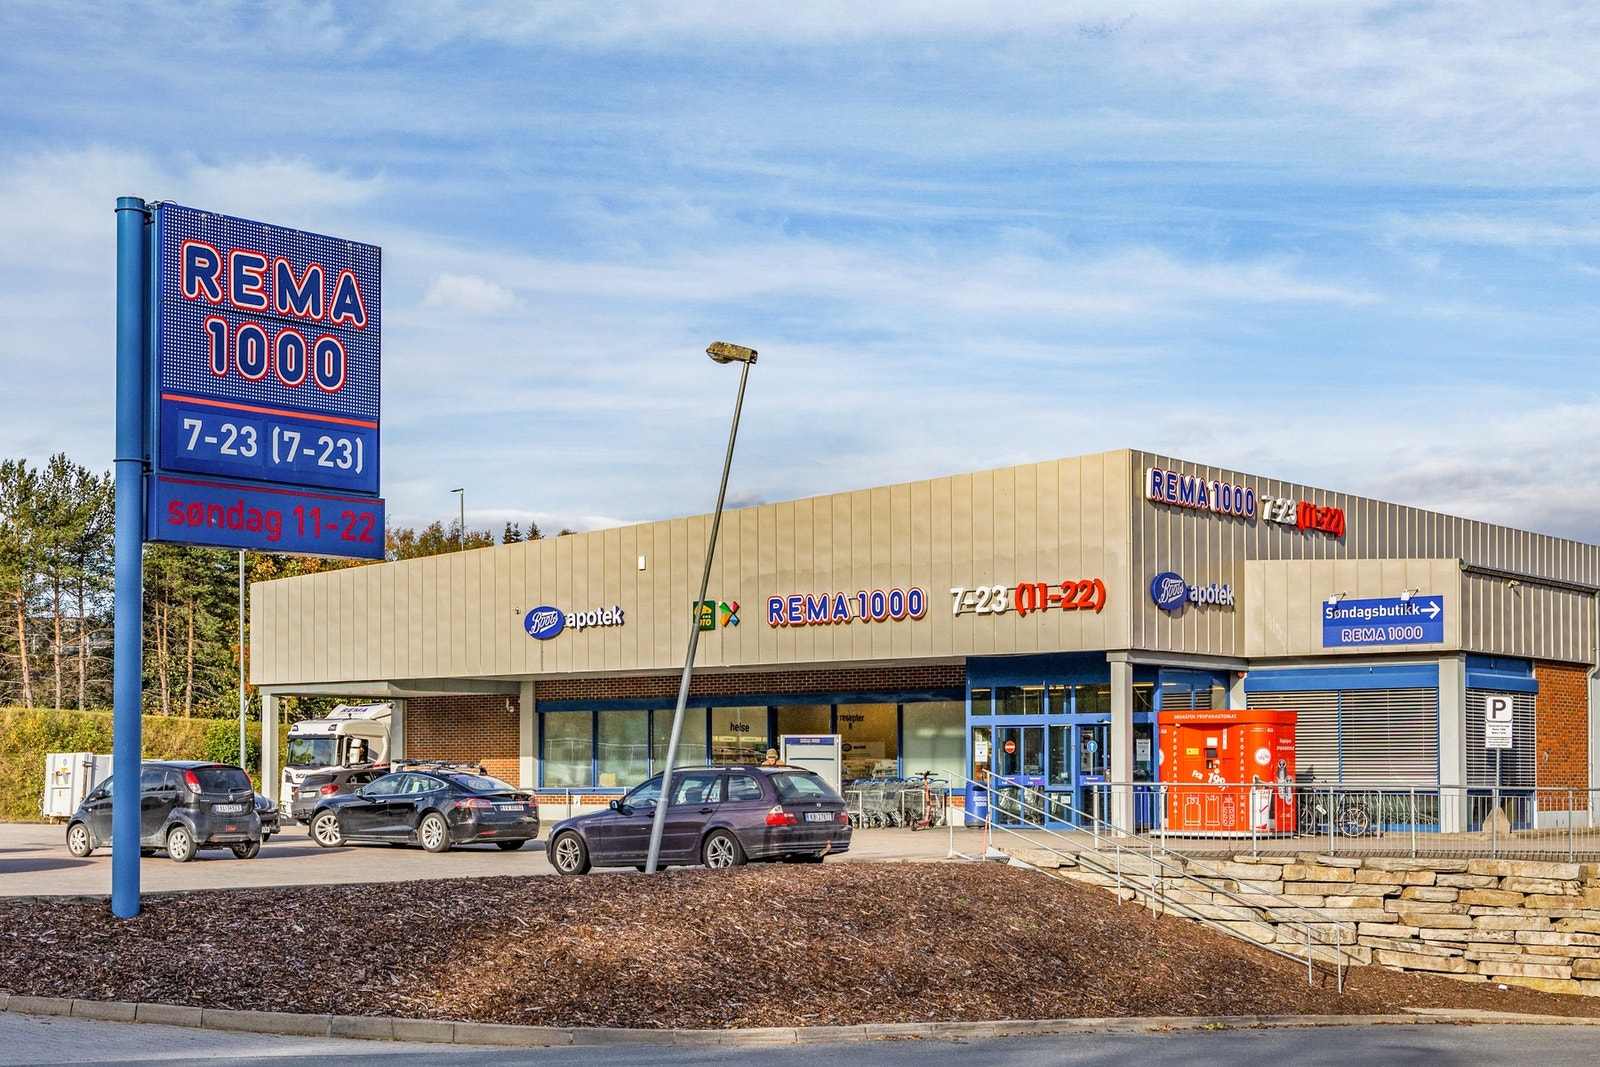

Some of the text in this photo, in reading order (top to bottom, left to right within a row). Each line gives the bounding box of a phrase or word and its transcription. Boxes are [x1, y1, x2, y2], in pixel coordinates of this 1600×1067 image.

[180, 239, 368, 329] REMA
[204, 315, 346, 393] 1000
[183, 418, 363, 474] 7-23 (7-23)
[1147, 467, 1209, 510] REMA
[1210, 481, 1255, 518] 1000
[1261, 495, 1297, 525] 7-23
[167, 498, 375, 543] søndag 11-22
[767, 578, 1106, 627] REMA 1000 7-23 (11-22)
[1159, 577, 1234, 606] Boots apotek
[529, 605, 623, 634] Boots apotek
[1325, 603, 1420, 621] Søndagsbutikk
[1342, 626, 1423, 642] REMA 1000
[730, 722, 750, 732] helse
[1492, 699, 1507, 719] P
